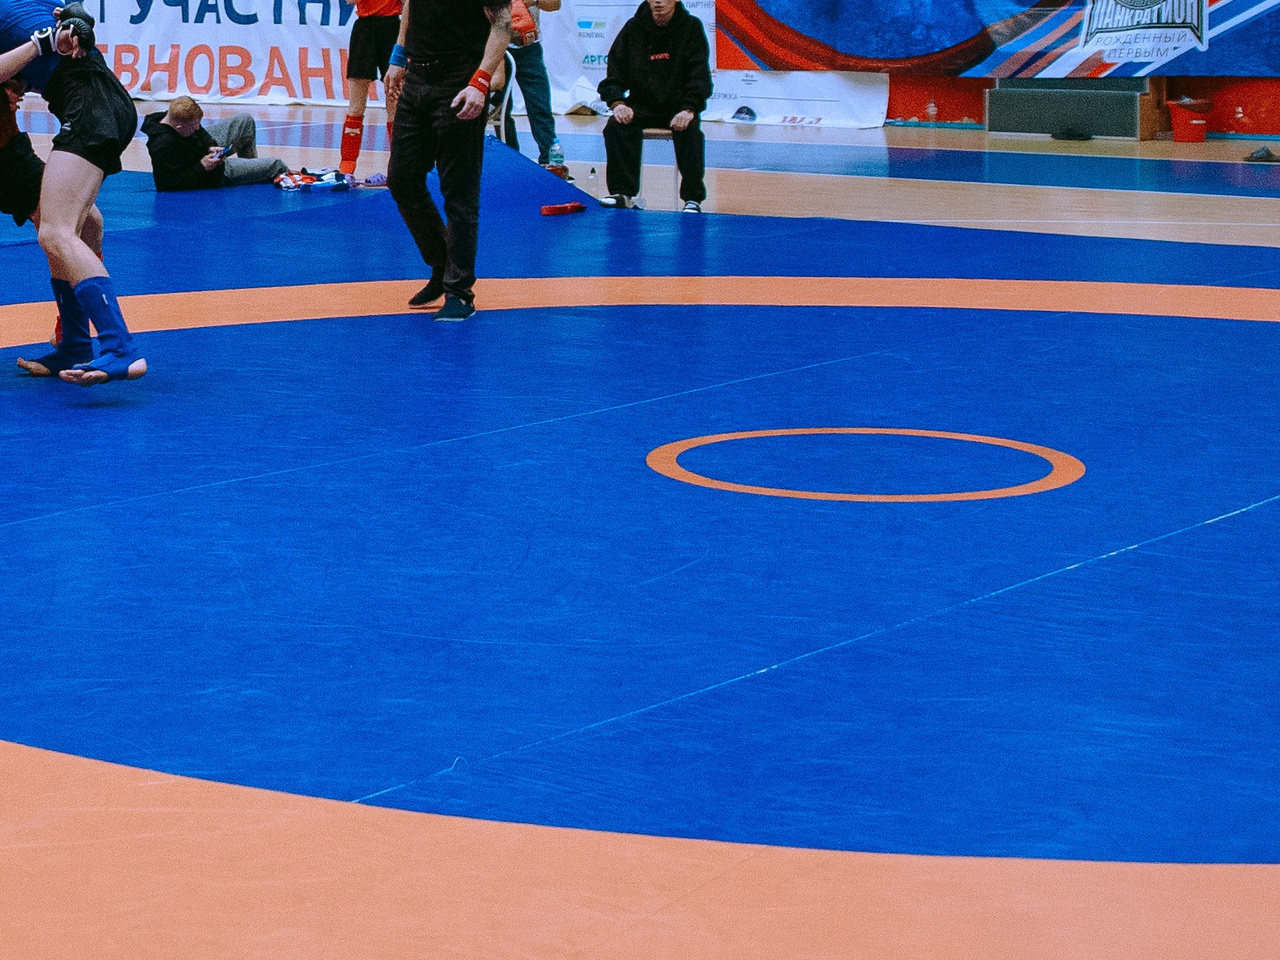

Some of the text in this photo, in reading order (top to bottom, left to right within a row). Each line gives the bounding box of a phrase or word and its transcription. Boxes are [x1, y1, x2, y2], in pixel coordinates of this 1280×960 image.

[1095, 29, 1187, 46] РОЖДЕННЫЙ
[1107, 46, 1170, 59] ПЕРВЫМ
[95, 43, 379, 101] ВНОВАН
[710, 92, 738, 100] ЕРЖКА
